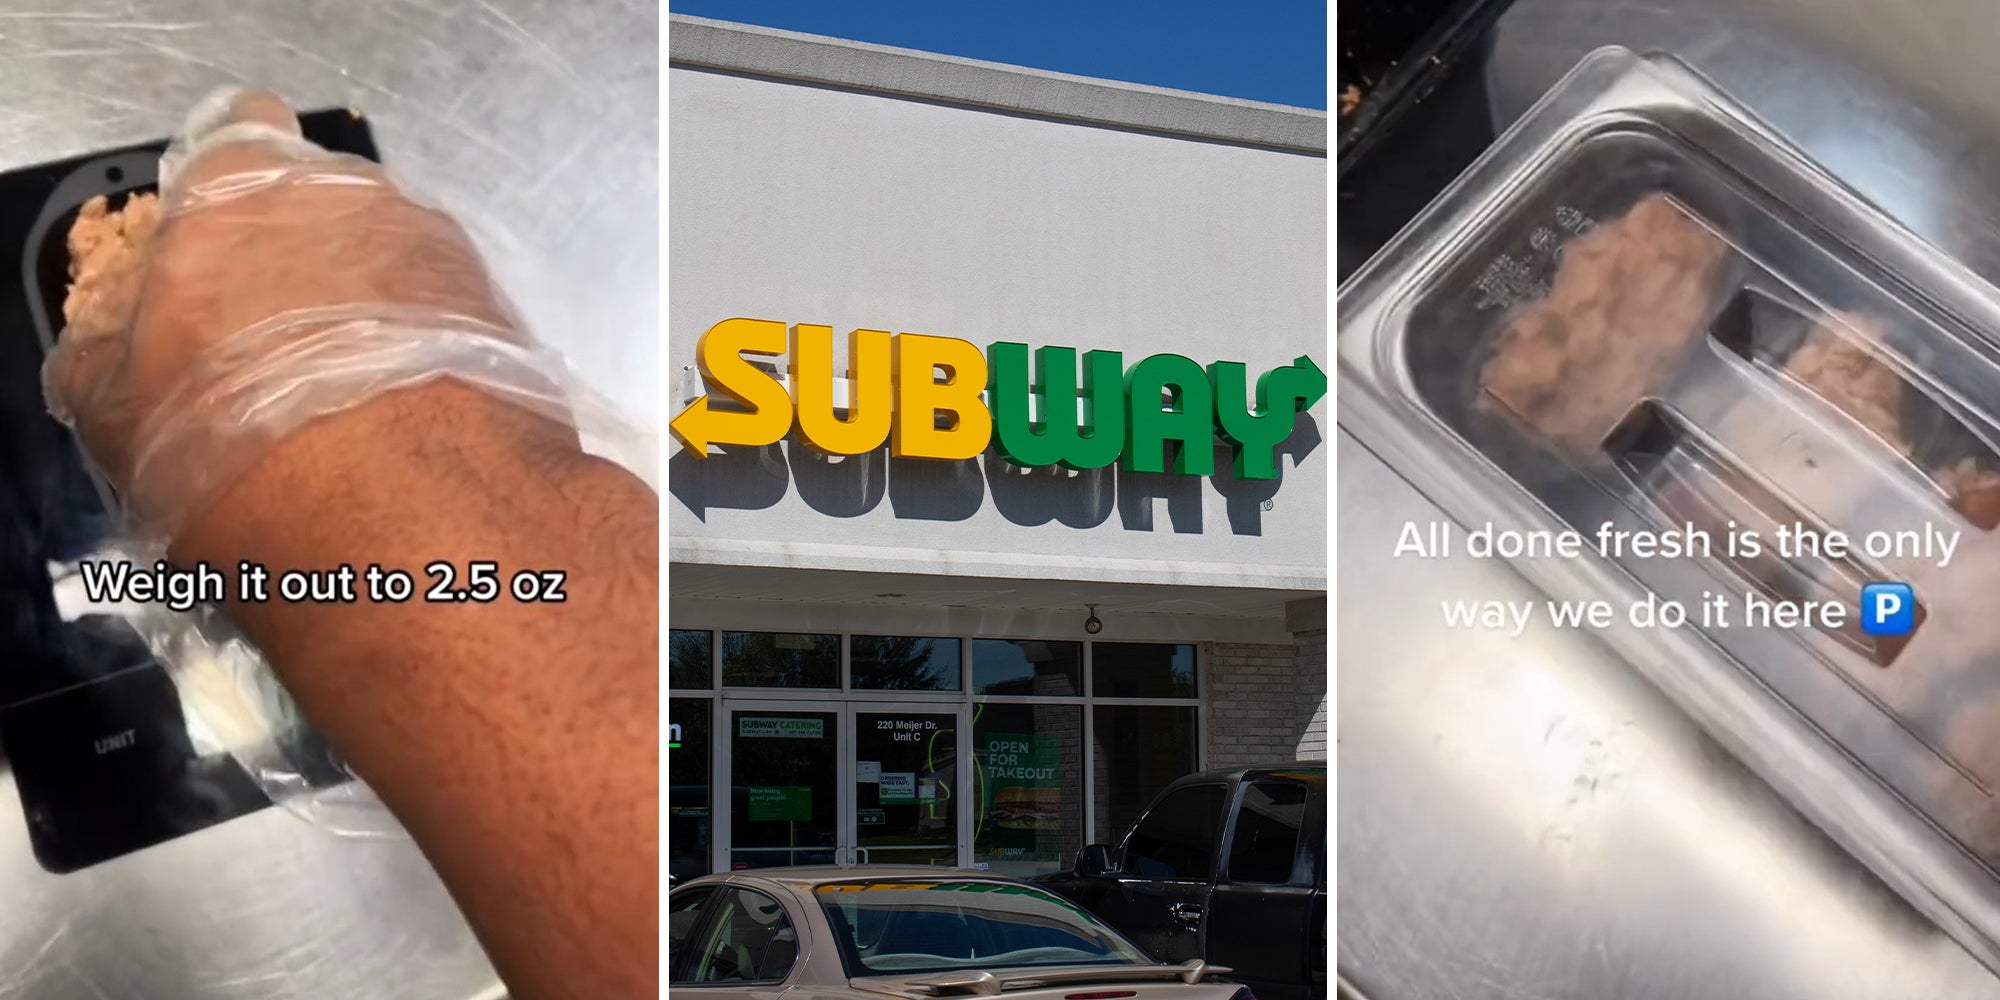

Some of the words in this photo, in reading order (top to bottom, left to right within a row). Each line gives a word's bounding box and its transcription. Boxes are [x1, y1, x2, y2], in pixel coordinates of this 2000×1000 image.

[669, 316, 1327, 480] SUBWAY
[742, 720, 777, 729] SUBWAY
[779, 721, 822, 730] CATERING
[877, 720, 893, 729] 220
[895, 720, 923, 731] Meijer
[925, 721, 937, 730] Dr.
[94, 728, 136, 754] UNIT
[893, 732, 912, 741] Unit
[913, 732, 921, 741] C
[989, 740, 1029, 753] OPEN
[989, 753, 1018, 766] FOR
[988, 766, 1055, 780] TAKEOUT
